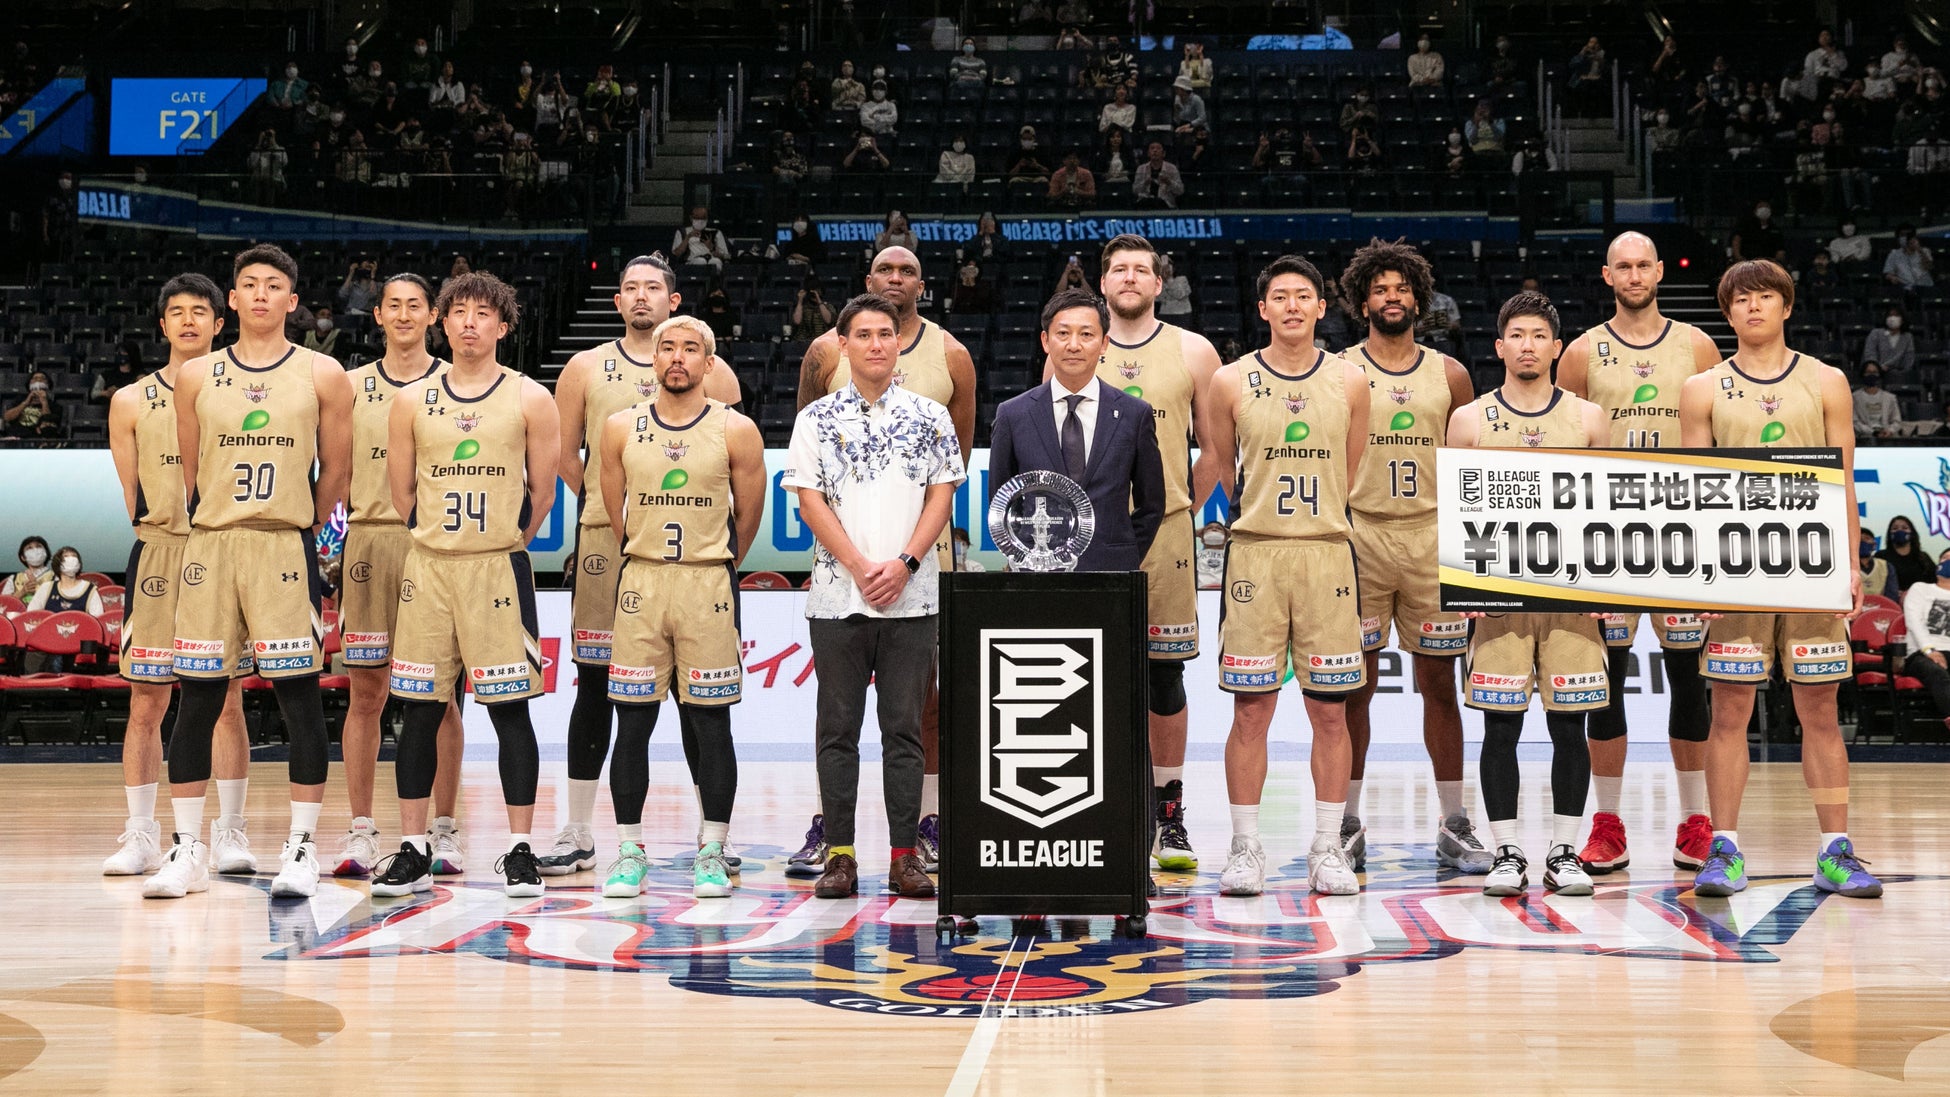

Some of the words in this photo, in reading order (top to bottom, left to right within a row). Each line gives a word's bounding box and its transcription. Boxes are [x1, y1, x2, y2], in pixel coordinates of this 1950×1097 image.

[171, 92, 206, 103] GATE
[159, 110, 218, 139] F21
[218, 434, 294, 447] Zenhoren
[1369, 433, 1434, 446] Zenhoren
[431, 464, 505, 477] Zenhoren
[1488, 471, 1540, 482] B.LEAGUE
[233, 461, 275, 502] 30
[1387, 459, 1418, 498] 13
[1277, 474, 1320, 516] 24
[1488, 484, 1541, 496] 2020-21
[1552, 472, 1594, 510] B1
[1607, 471, 1820, 511] 西地区優勝
[639, 492, 712, 507] Zenhoren
[1488, 497, 1542, 509] SEASON
[442, 490, 487, 532] 34
[663, 521, 684, 561] 3
[1462, 520, 1835, 583] ¥10,000,000
[269, 640, 311, 651] 琉球銀行
[147, 650, 173, 659] 琉球ダイ
[133, 664, 173, 676] 琉球新
[487, 665, 527, 677] 琉球銀行
[477, 680, 528, 695] 沖縄タイムス
[980, 840, 1104, 867] B.LEAGUE
[829, 998, 1173, 1016] GOLDEN
